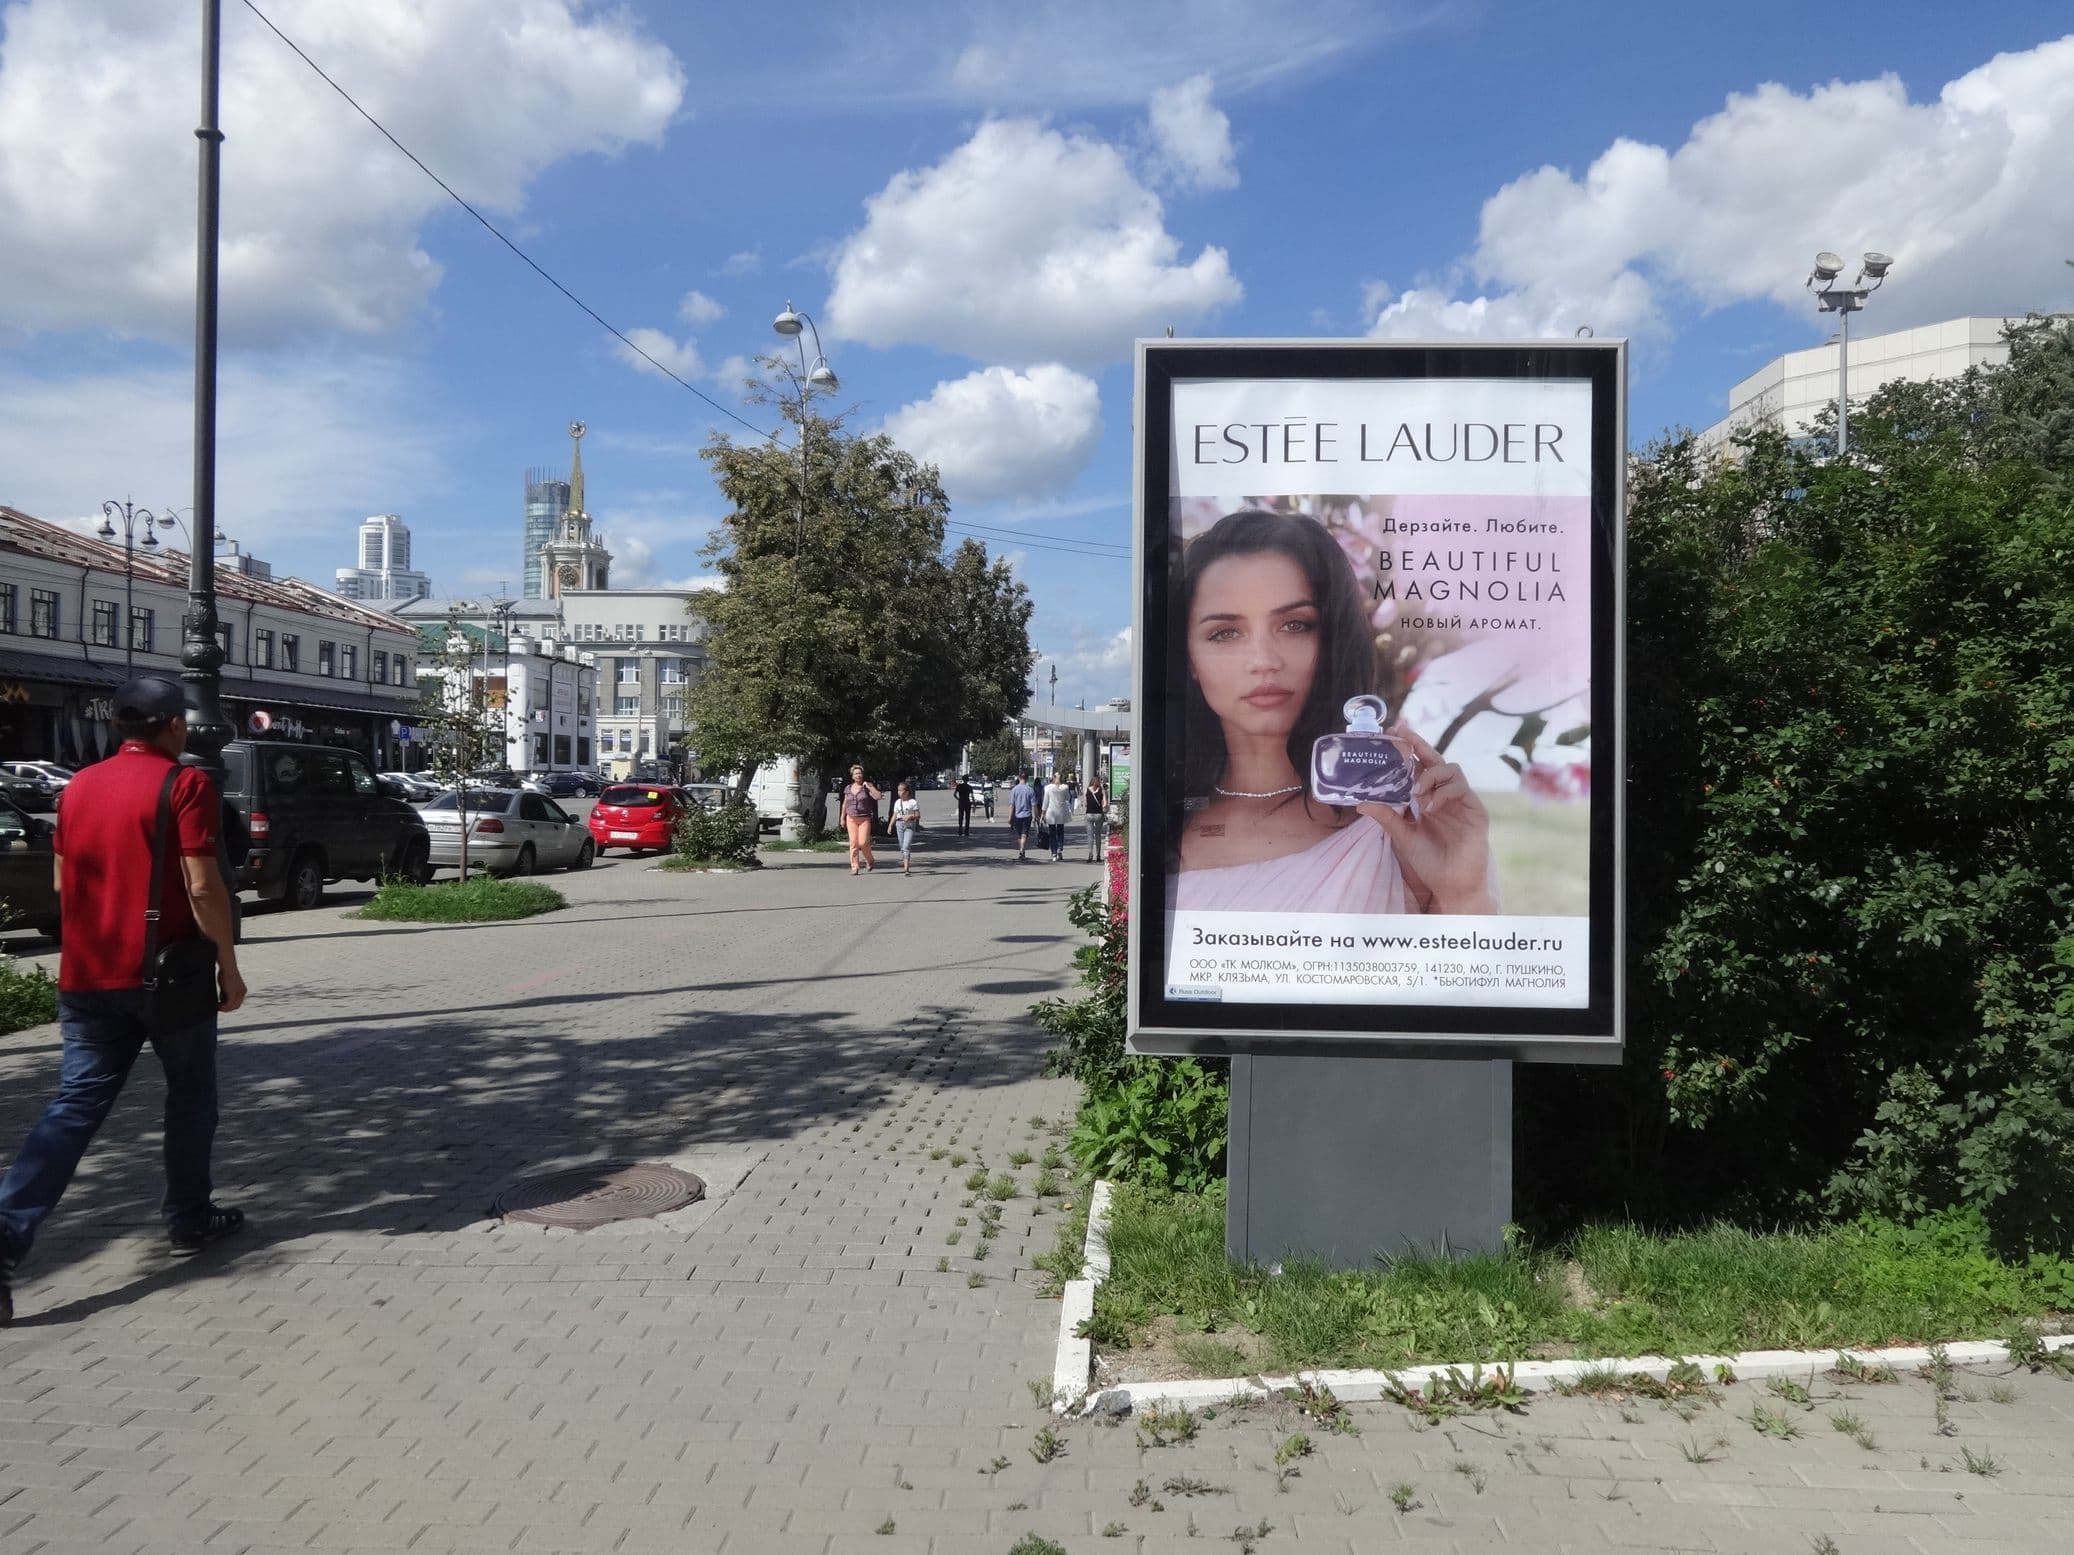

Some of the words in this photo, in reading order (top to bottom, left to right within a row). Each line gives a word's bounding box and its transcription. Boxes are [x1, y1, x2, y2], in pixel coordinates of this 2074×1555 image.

[1360, 423, 1564, 463] LAUDER
[1383, 518, 1477, 536] Дерзайте.
[1486, 518, 1564, 534] Любите.
[1380, 551, 1561, 572] BEAUTIFUL
[1373, 580, 1566, 602] MAGNOLIA
[1401, 615, 1461, 629] НОВЫЙ
[1469, 618, 1542, 630] АРОМАТ.
[1342, 751, 1388, 759] BEAUTIFUL
[1192, 927, 1323, 948] Заказывайте
[1330, 935, 1354, 948] на
[1362, 931, 1563, 951] www.esteelauder.ru
[1189, 959, 1218, 969] ООО
[1221, 960, 1237, 970] «ТК
[1240, 960, 1299, 972] МОЛКОМ»,
[1425, 963, 1465, 975] 141230,
[1469, 964, 1492, 976] МО,
[1495, 965, 1503, 975] Г.
[1506, 965, 1566, 977] ПУШКИНО,
[1190, 972, 1213, 983] МКР.
[1218, 972, 1270, 984] КЛЯЗЬМА,
[1275, 974, 1291, 984] УЛ.
[1296, 974, 1401, 987] КОСТОМАРОВСКАЯ,
[1504, 978, 1566, 989] МАГНОЛИЯ
